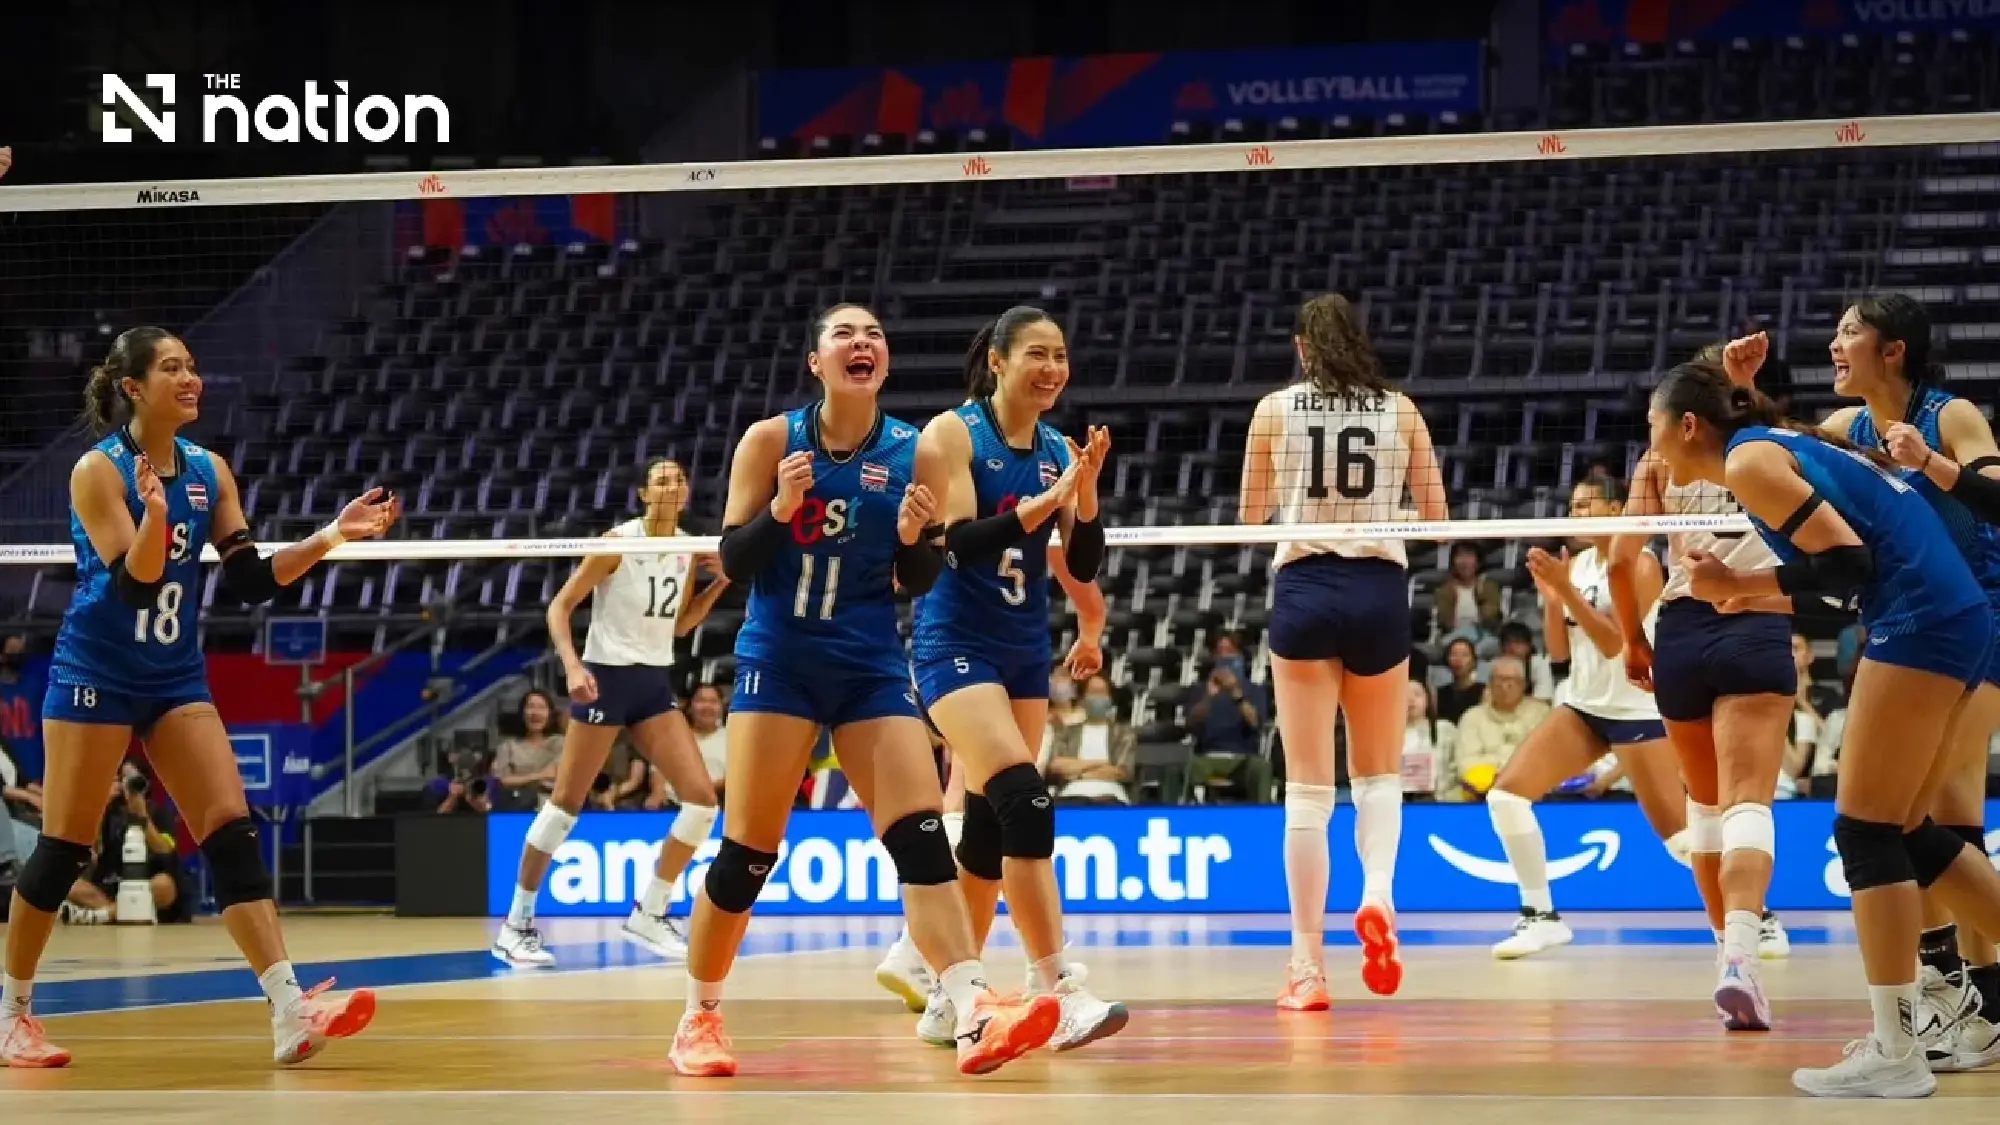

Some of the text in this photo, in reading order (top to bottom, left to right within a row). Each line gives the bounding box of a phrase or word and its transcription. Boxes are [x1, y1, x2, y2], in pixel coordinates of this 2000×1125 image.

[1227, 75, 1409, 105] VOLLEYBALL
[1537, 134, 1566, 154] VNL
[1835, 122, 1865, 142] VNL
[962, 155, 991, 175] VNL
[1293, 391, 1386, 412] RETTKE
[1307, 426, 1376, 499] 16
[792, 496, 863, 547] est
[165, 519, 196, 560] st
[794, 554, 841, 620] 11
[997, 547, 1026, 606] 5
[643, 575, 678, 620] 12
[135, 582, 183, 645] 18
[953, 656, 970, 674] 5
[73, 687, 97, 708] 18
[744, 670, 761, 695] 11
